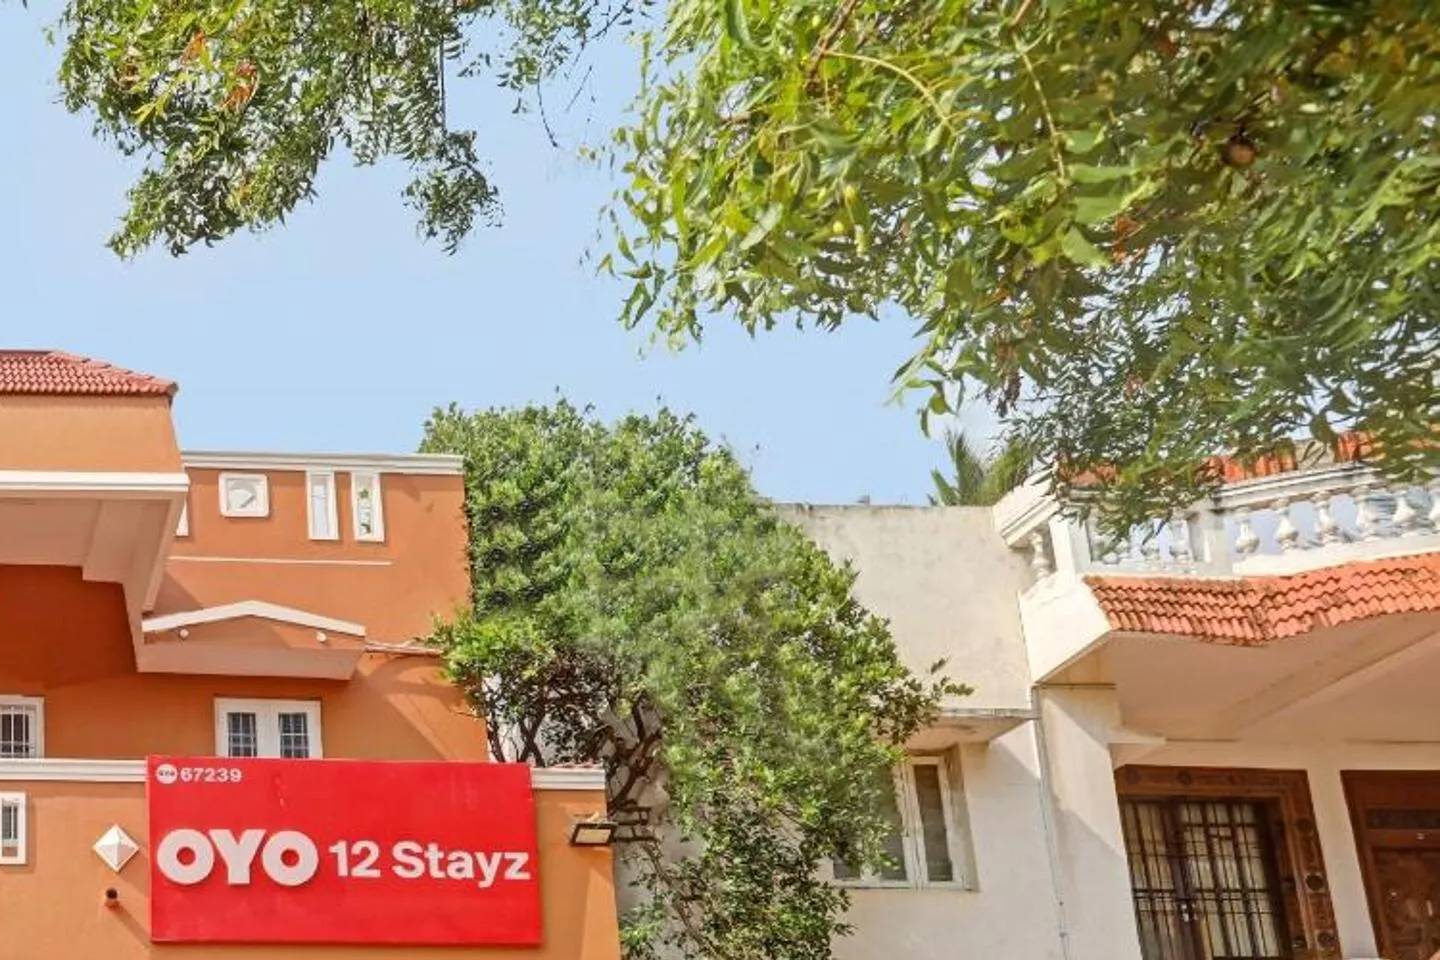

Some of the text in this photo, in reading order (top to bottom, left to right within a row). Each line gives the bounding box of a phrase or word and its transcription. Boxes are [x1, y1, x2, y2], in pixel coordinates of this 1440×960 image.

[180, 767, 242, 783] 67239
[157, 828, 531, 888] OYO 12 Stayz
